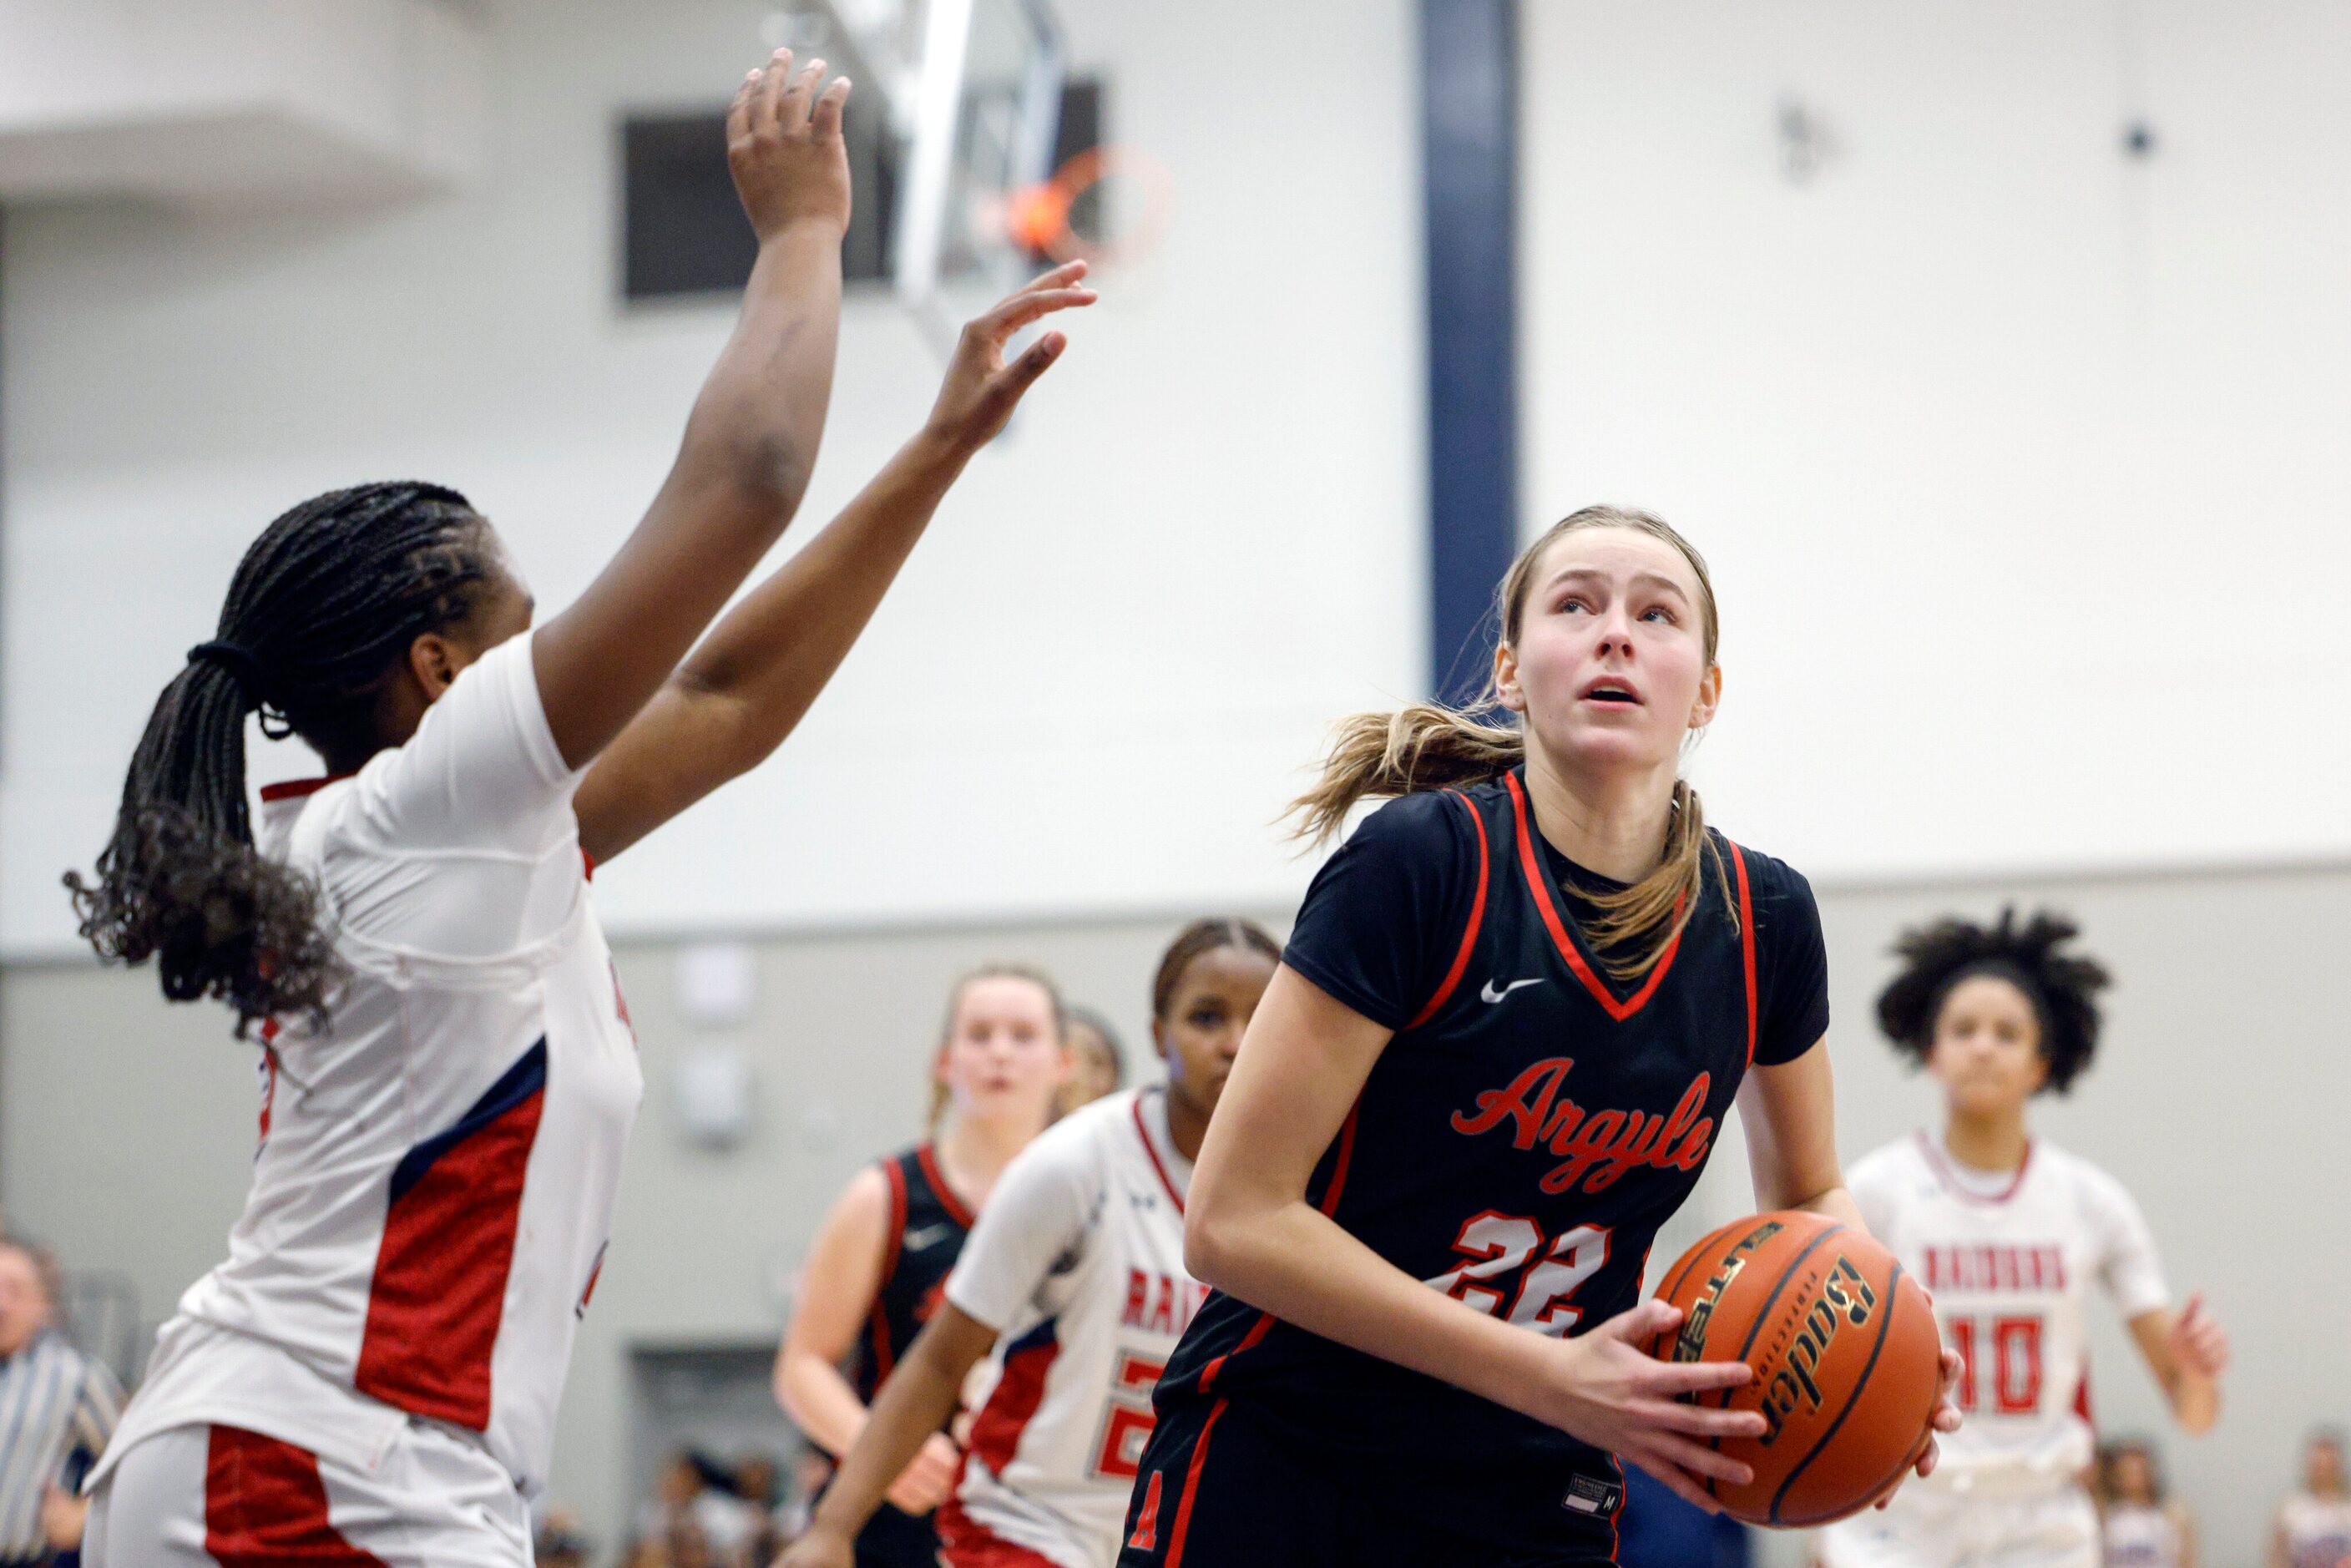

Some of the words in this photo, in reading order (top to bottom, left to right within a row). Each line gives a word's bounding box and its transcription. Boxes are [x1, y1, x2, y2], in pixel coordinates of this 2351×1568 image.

[1450, 1056, 1713, 1194] Argyle
[1420, 1208, 1611, 1339] 22
[1944, 1313, 2044, 1415] 10
